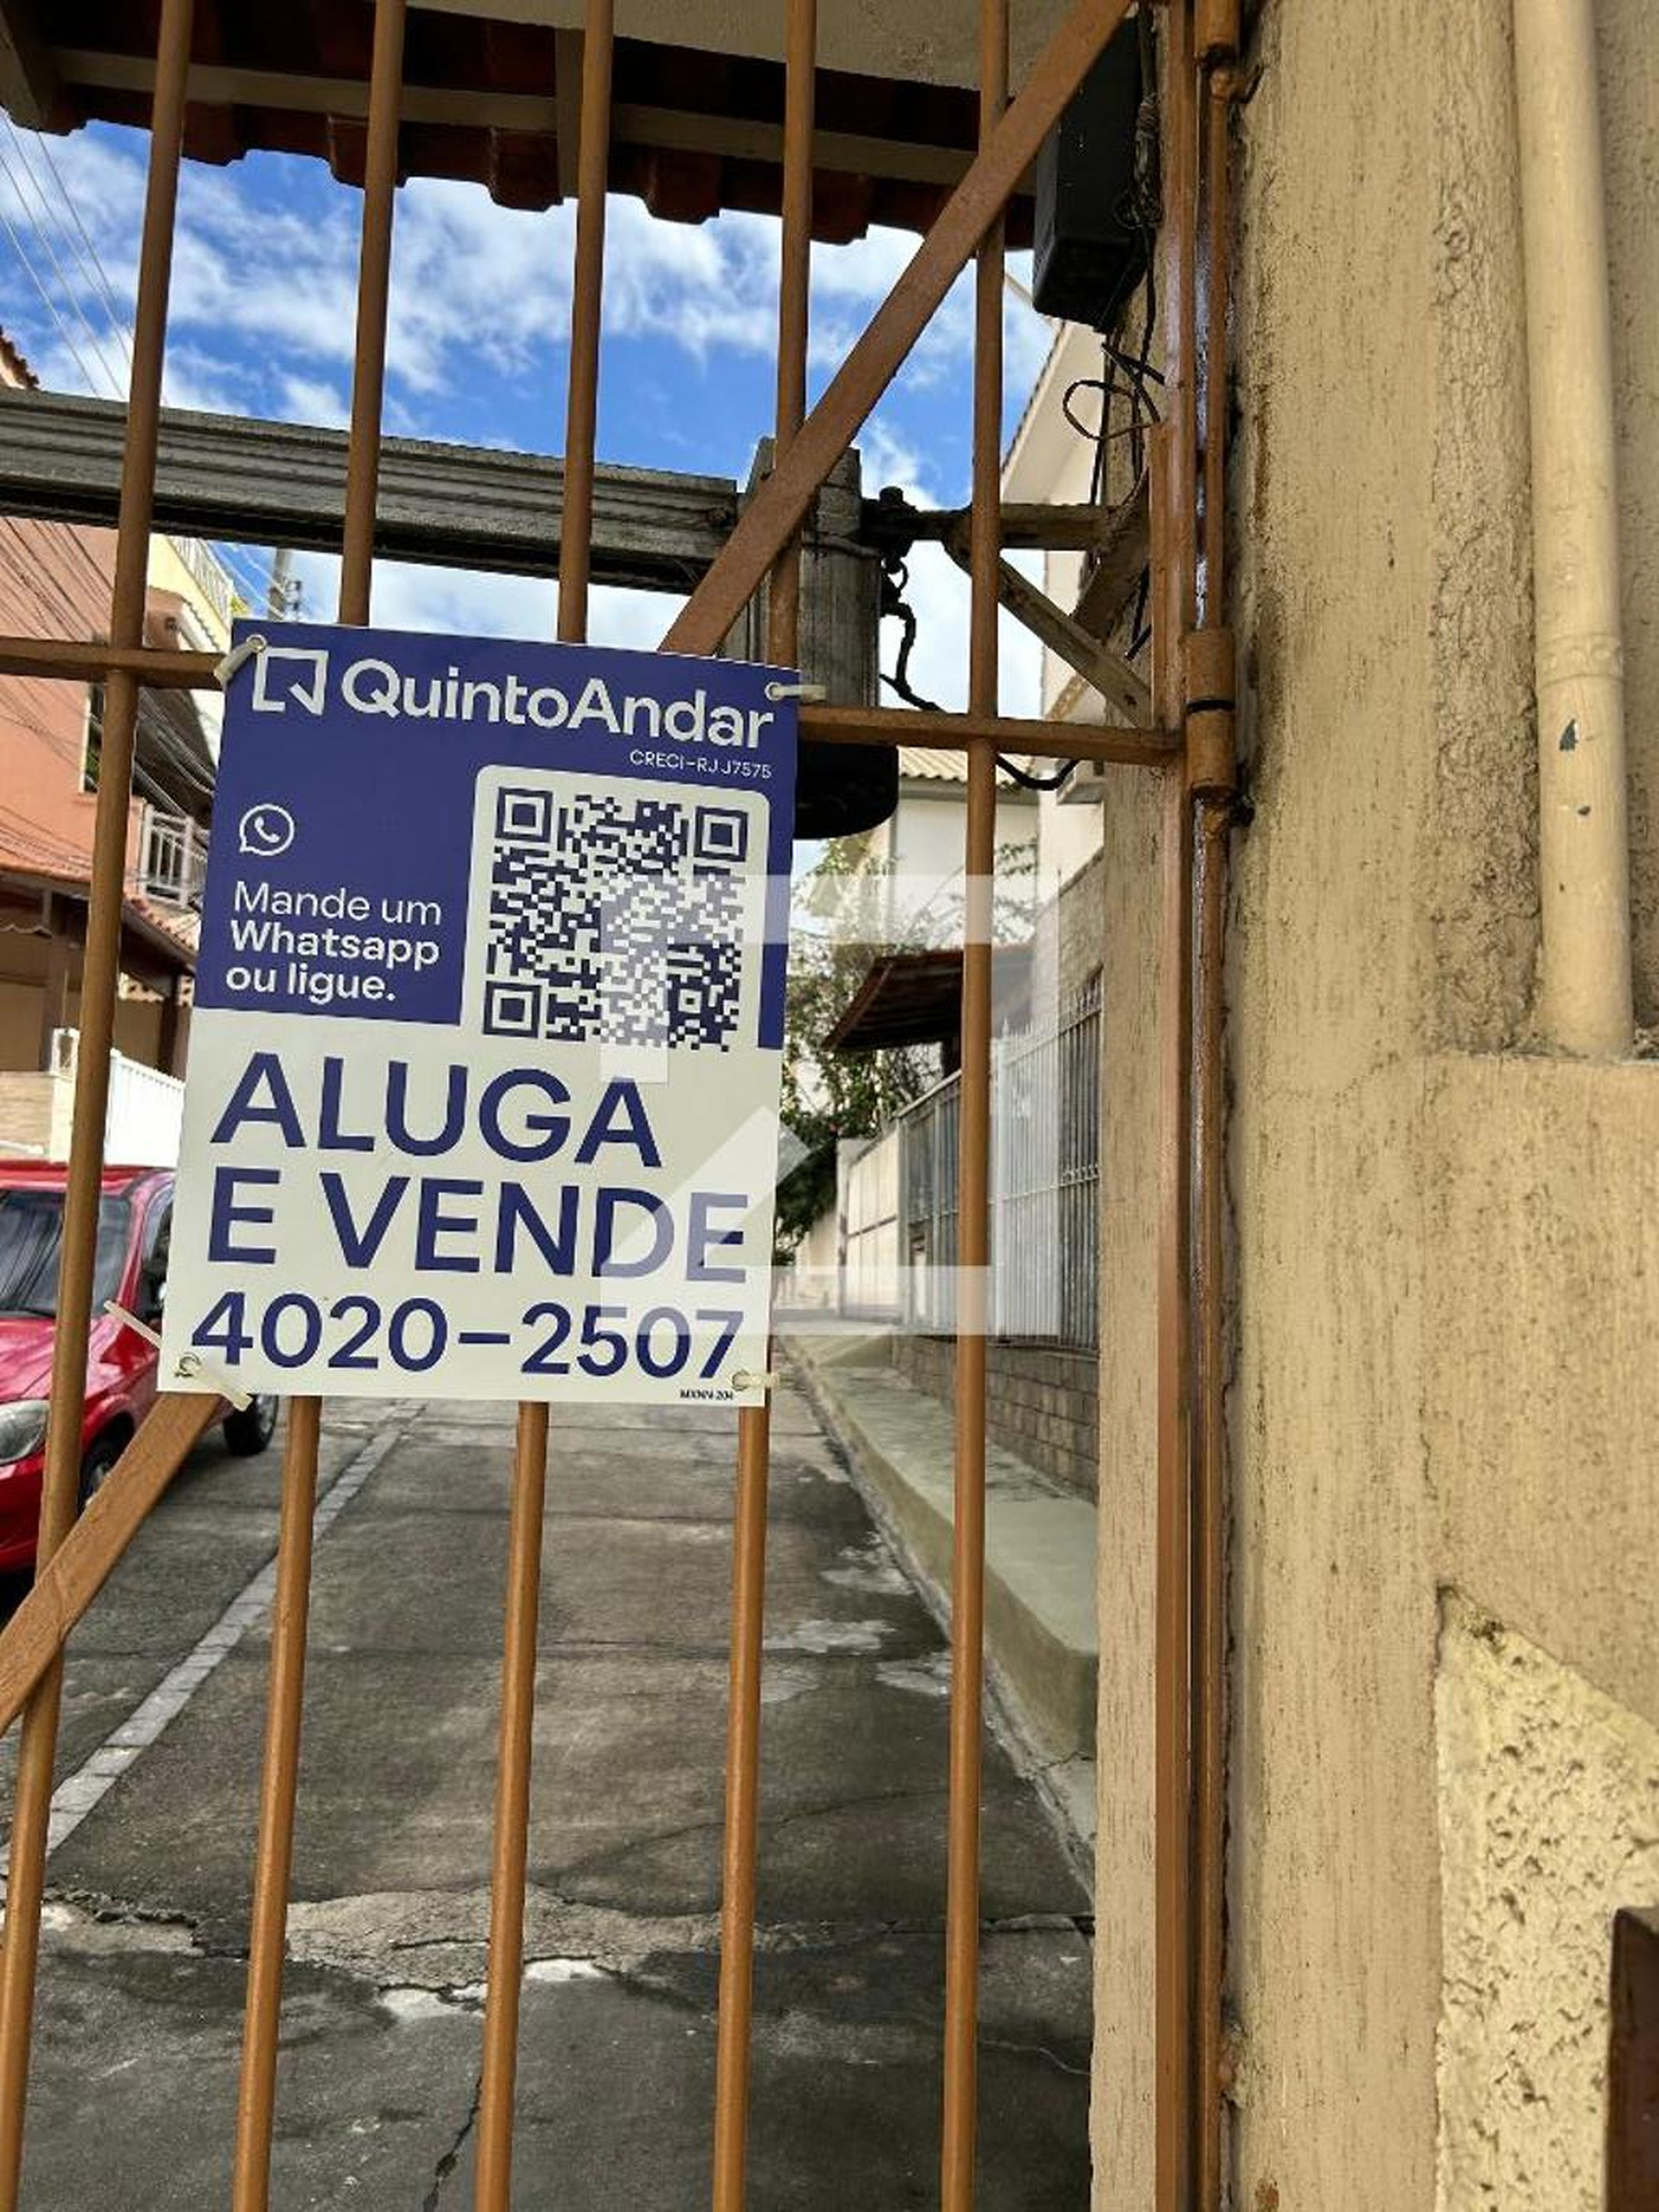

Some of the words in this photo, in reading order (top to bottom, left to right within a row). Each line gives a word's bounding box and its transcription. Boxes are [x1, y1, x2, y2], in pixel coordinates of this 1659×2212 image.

[341, 658, 775, 748] QuintoAndar
[230, 920, 439, 971] Whatsapp
[234, 880, 371, 921] Mande
[382, 899, 442, 926] um
[226, 967, 276, 993] ou
[288, 962, 395, 1005] ligue.
[210, 1051, 662, 1168] ALUGA
[207, 1166, 281, 1264] E
[320, 1171, 749, 1283] VENDE
[191, 1292, 744, 1380] 4020-2507
